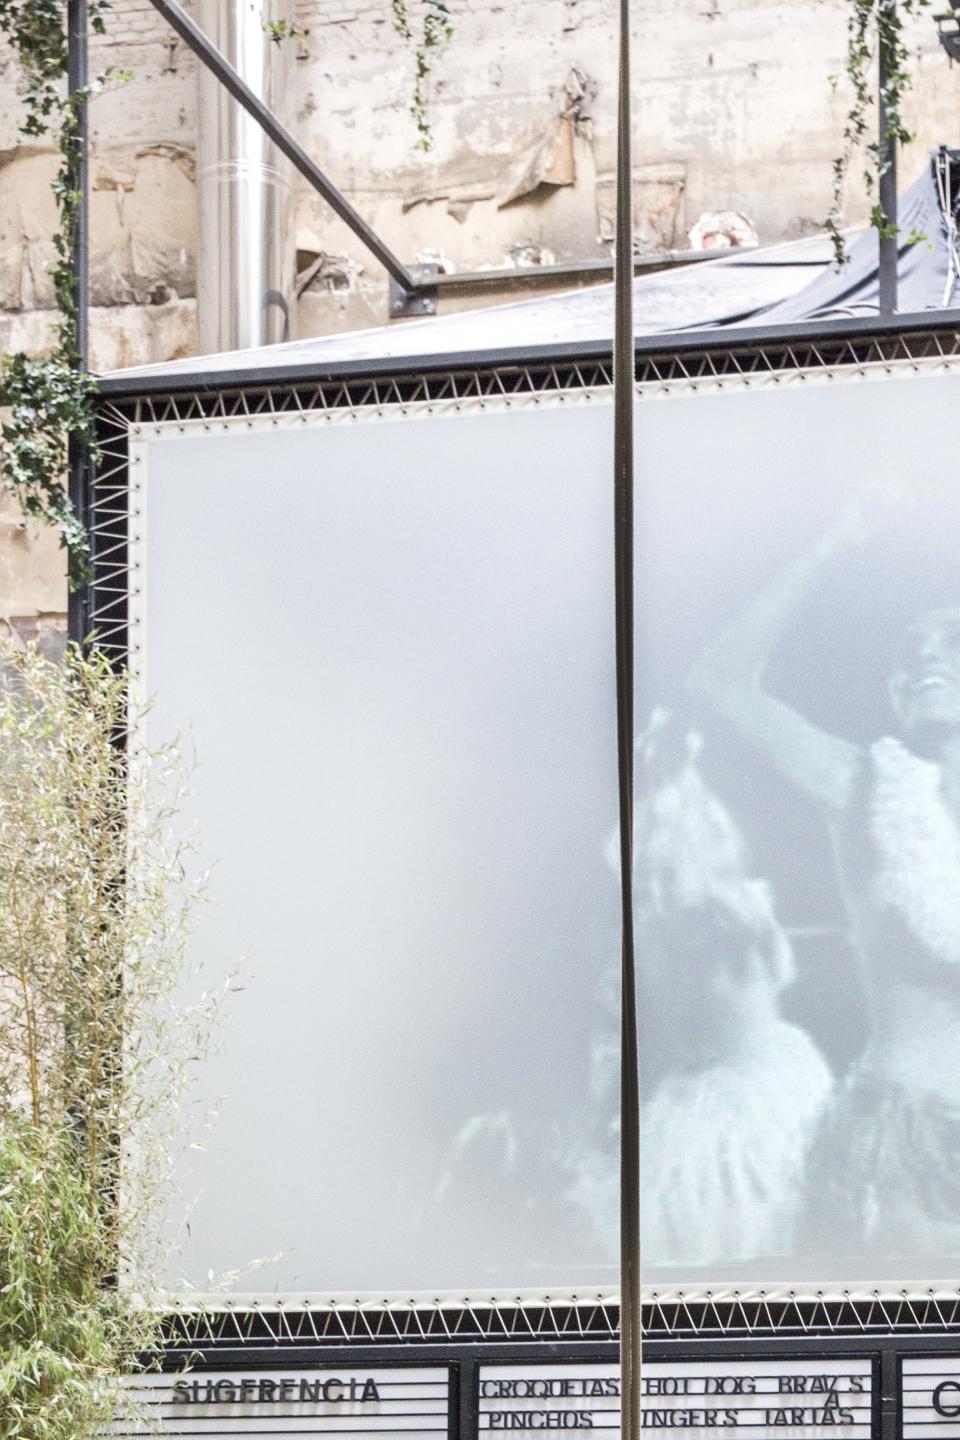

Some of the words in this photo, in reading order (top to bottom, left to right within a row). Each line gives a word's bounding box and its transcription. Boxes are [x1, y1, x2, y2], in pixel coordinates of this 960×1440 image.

[172, 1378, 381, 1404] SUGERENCIA
[481, 1377, 620, 1400] CROQUETAS
[705, 1376, 756, 1395] DOG
[488, 1410, 593, 1430] PINCHOS
[642, 1408, 739, 1428] INGERS
[766, 1406, 855, 1426] TARTAS
